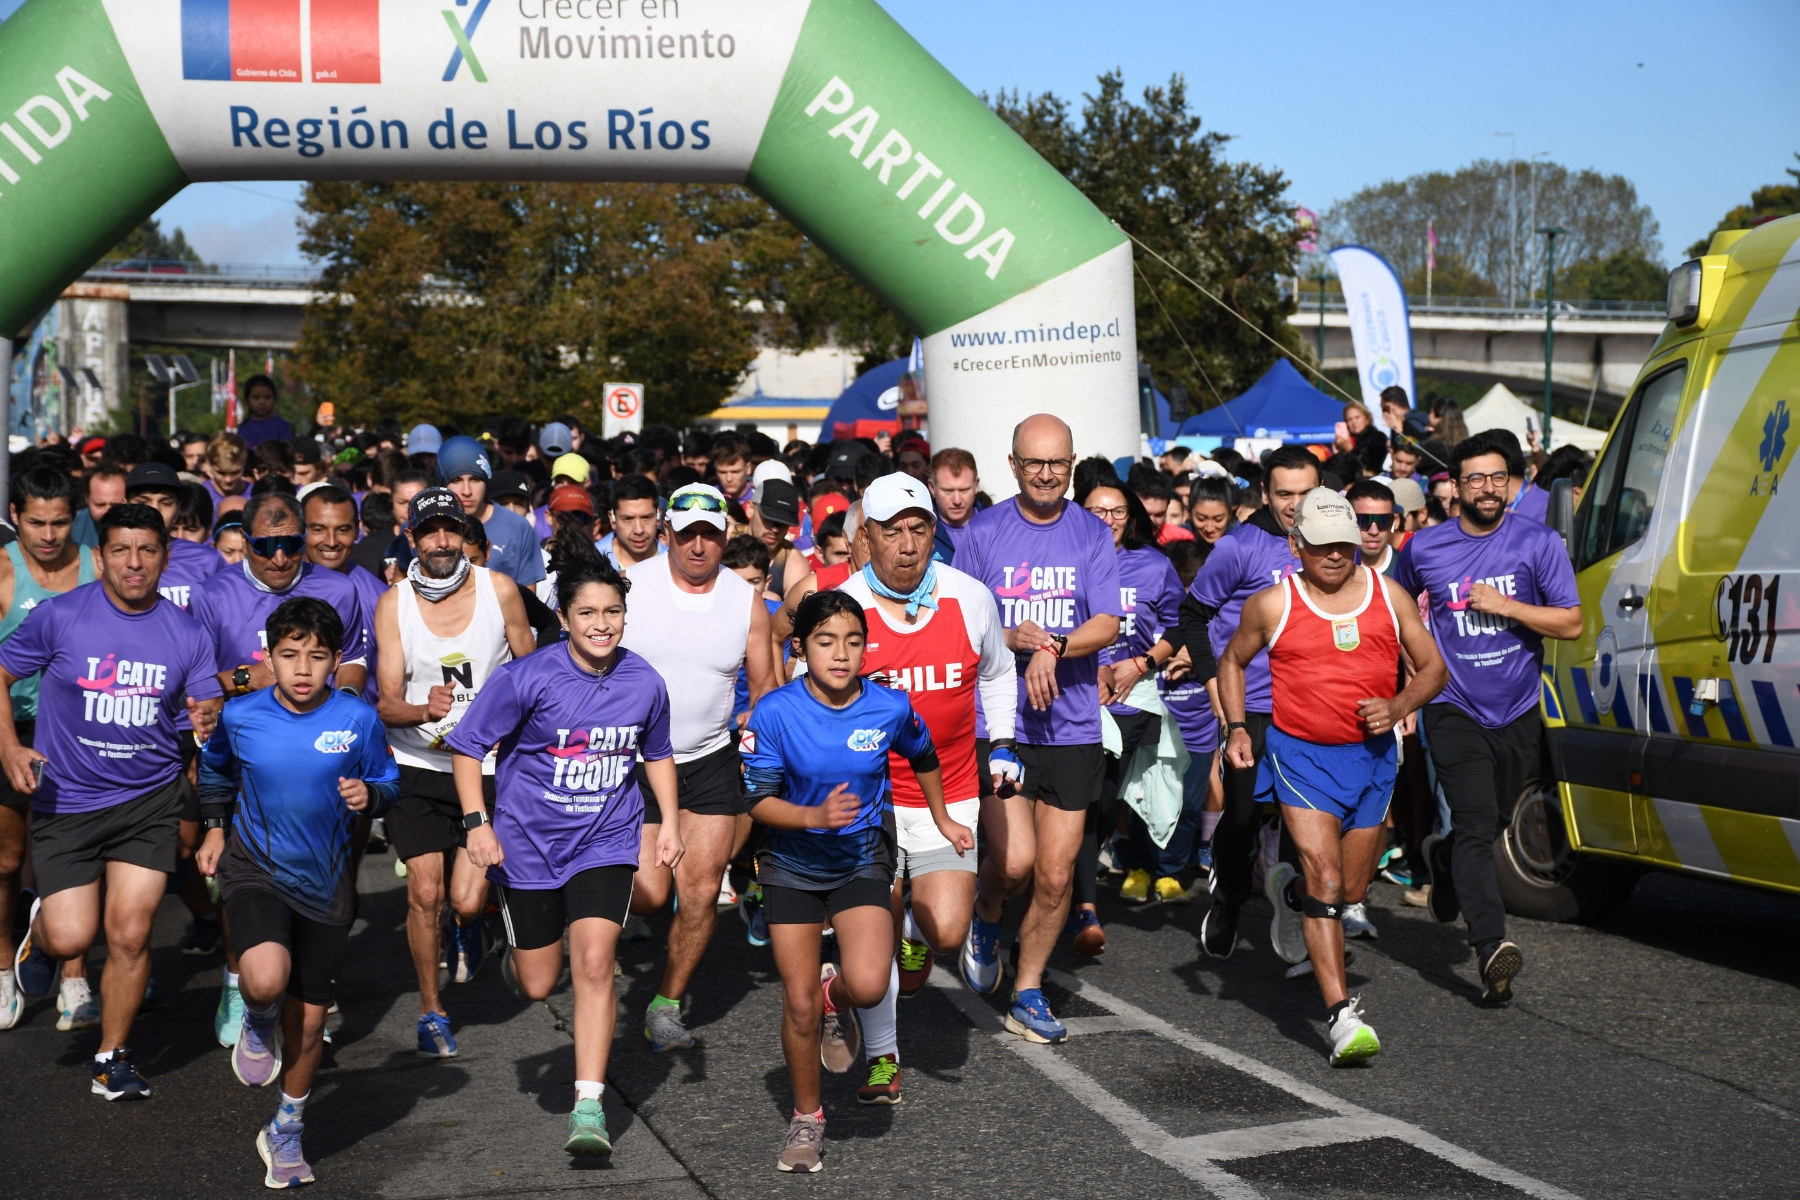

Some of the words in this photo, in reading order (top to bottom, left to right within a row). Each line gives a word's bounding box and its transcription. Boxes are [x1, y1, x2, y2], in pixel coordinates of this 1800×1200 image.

[519, 0, 629, 19] Crecer
[641, 0, 679, 19] en
[519, 26, 736, 59] Movimiento
[236, 68, 268, 77] Gobierno
[269, 69, 278, 77] de
[279, 69, 297, 78] Chile
[315, 70, 338, 79] gob.cl
[229, 105, 409, 158] Región
[428, 107, 487, 150] de
[507, 109, 589, 150] Los
[608, 107, 711, 151] Ríos
[804, 75, 1016, 281] PARTIDA
[951, 318, 1121, 348] www.mindep.cl
[953, 350, 1122, 372] #CrecerEnMovimiento
[1002, 598, 1075, 629] TOQUE
[1728, 574, 1780, 665] 131
[441, 661, 474, 689] N
[83, 690, 161, 728] TOQUE
[434, 720, 458, 735] Carnes
[566, 804, 574, 812] de
[573, 795, 601, 804] Temprana
